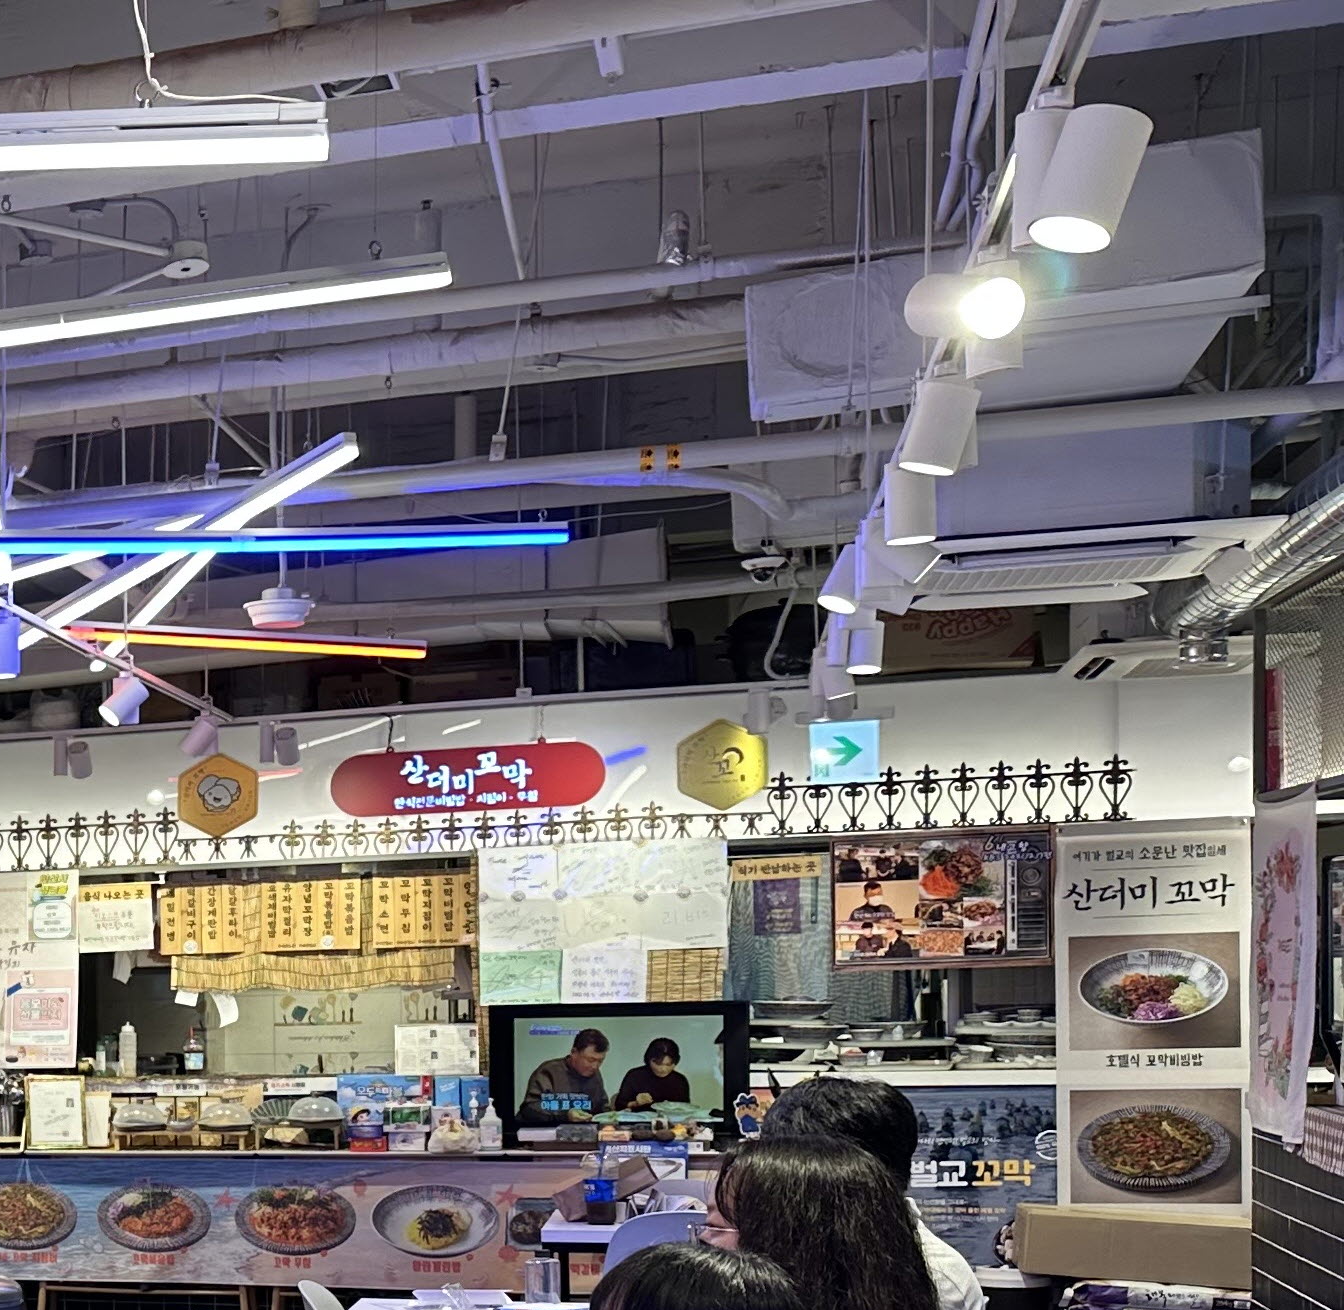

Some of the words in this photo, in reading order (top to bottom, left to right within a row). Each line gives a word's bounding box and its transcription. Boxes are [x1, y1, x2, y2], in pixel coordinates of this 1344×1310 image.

[1138, 845, 1177, 860] 소문난
[84, 891, 100, 902] 음식
[104, 890, 131, 900] 나오는
[135, 889, 144, 900] 곳
[1063, 875, 1158, 911] 산더미
[1165, 873, 1236, 907] 꼬막
[399, 879, 411, 934] 꼬막무침
[443, 877, 455, 932] 꼬막비빔밥
[8, 940, 36, 955] 유자
[1145, 1053, 1204, 1067] 꼬막비빔밥
[910, 1159, 968, 1188] 벌교
[971, 1159, 1036, 1187] 꼬막
